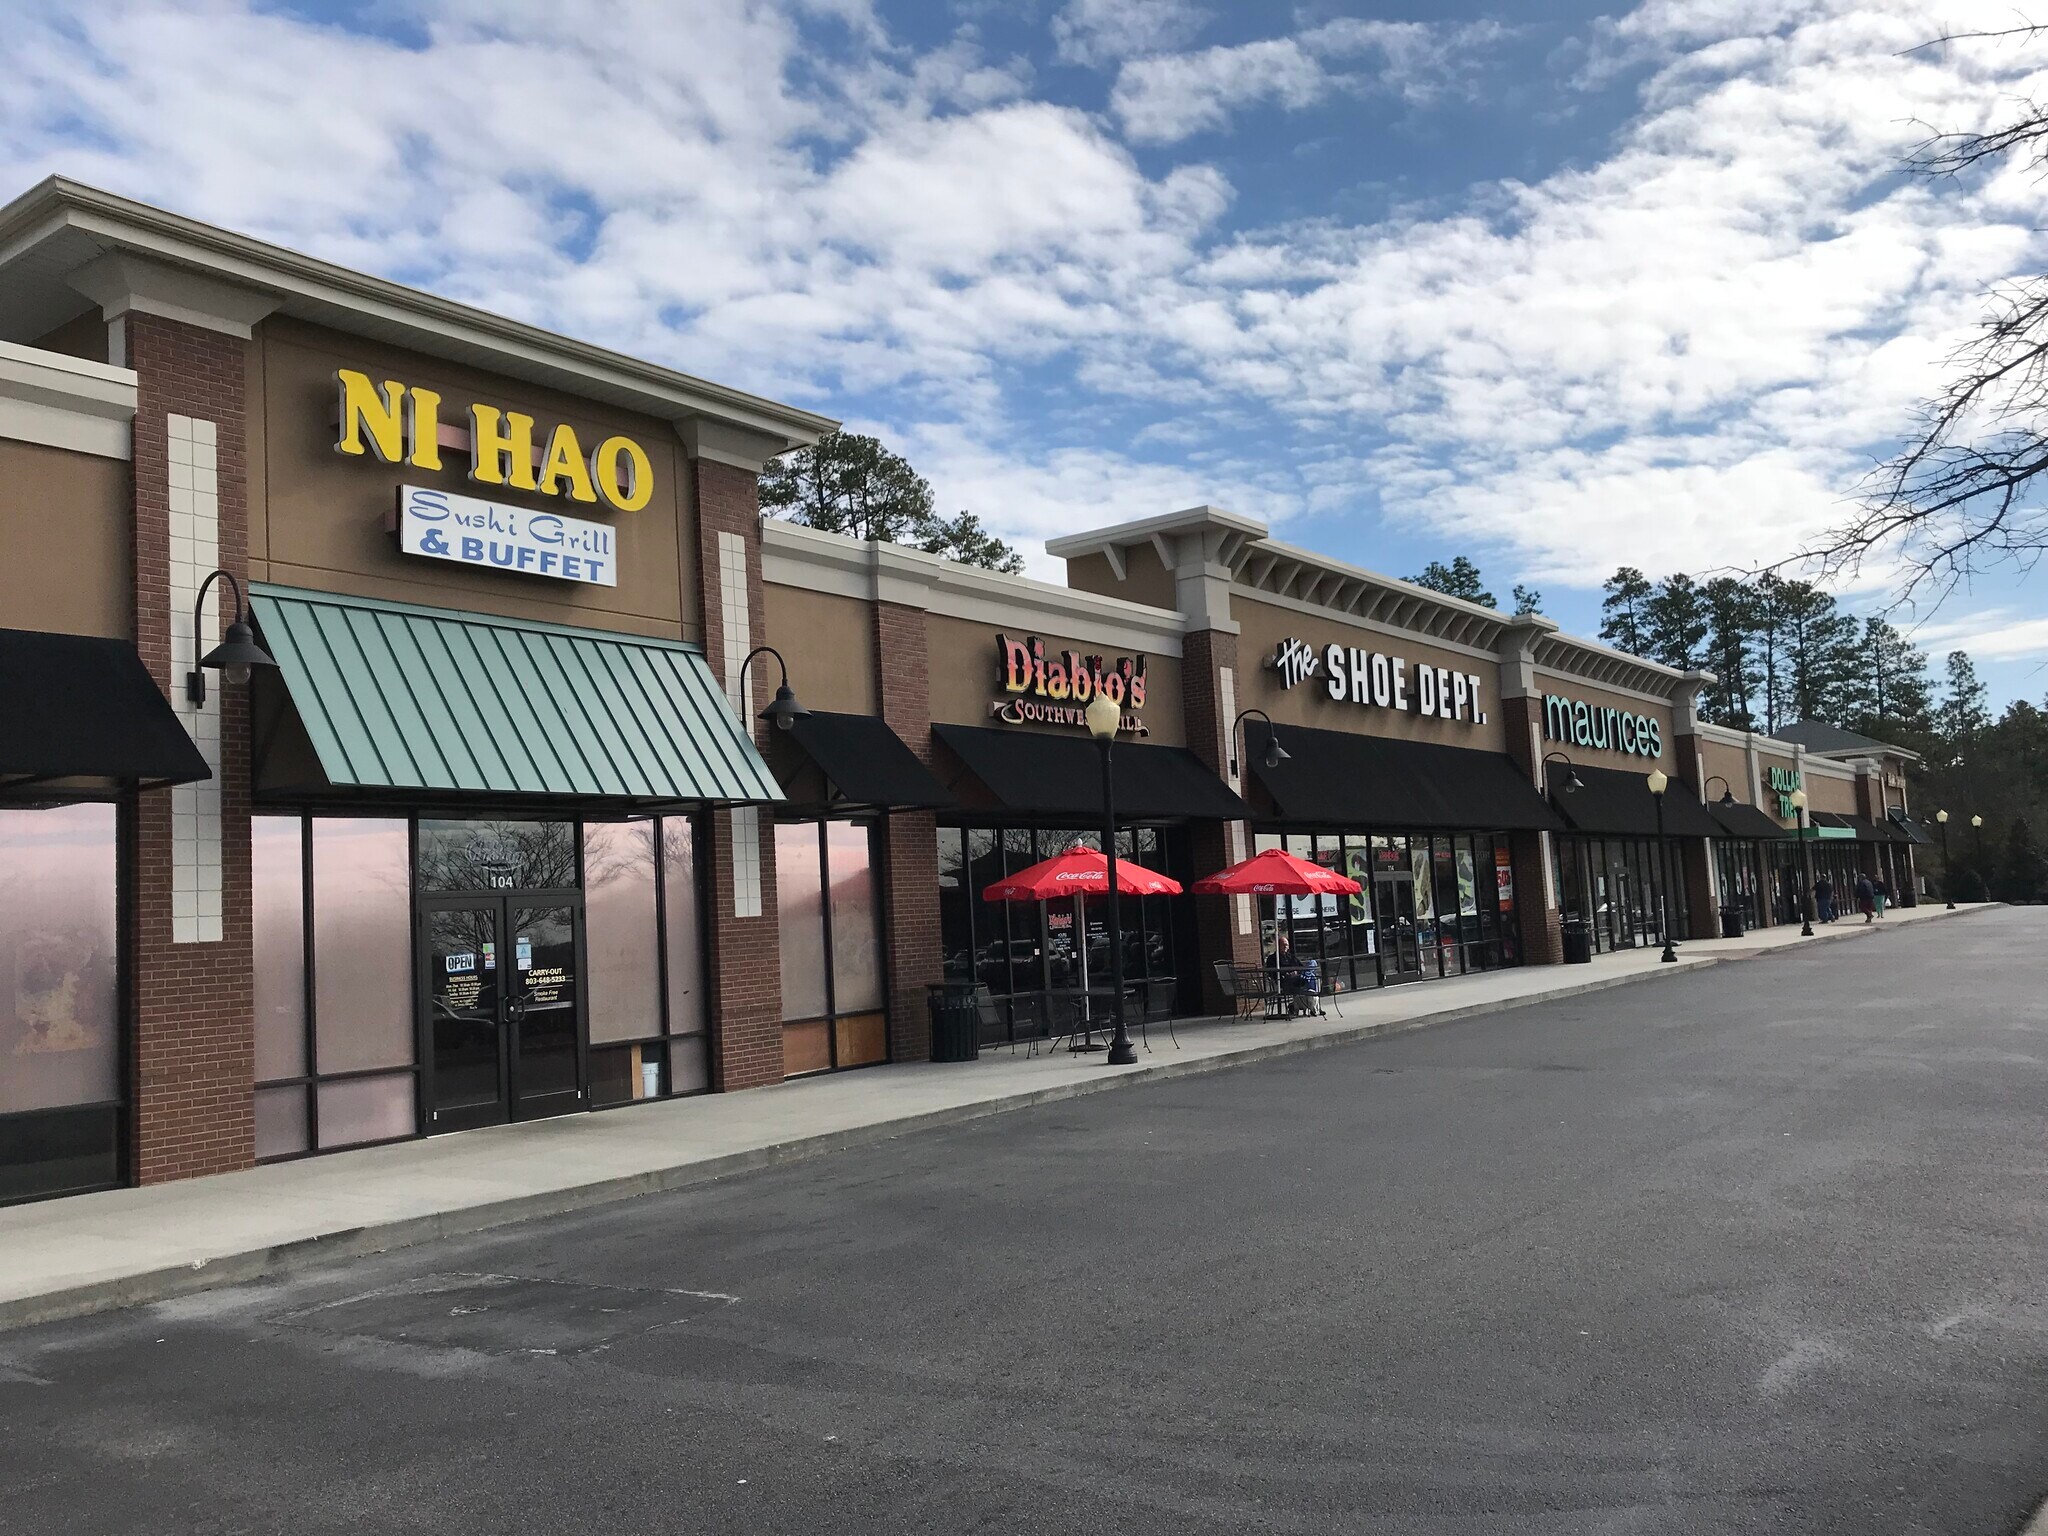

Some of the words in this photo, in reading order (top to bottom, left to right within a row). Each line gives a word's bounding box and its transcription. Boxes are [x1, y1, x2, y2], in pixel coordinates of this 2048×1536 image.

[336, 368, 443, 471] NI
[469, 402, 654, 512] HAO
[408, 490, 518, 537] Sushi
[527, 514, 610, 556] Grill
[419, 528, 451, 556] &
[461, 536, 605, 582] BUFFET
[999, 633, 1148, 710] Diablo's
[1275, 636, 1320, 691] the
[1326, 643, 1409, 712] SHOE
[1417, 663, 1488, 726] DEPT.
[1000, 698, 1090, 727] SOUTHWE
[1544, 693, 1663, 759] maurices
[1770, 766, 1801, 793] DOLLAR
[490, 876, 514, 888] 104
[1055, 870, 1105, 881] Coca-Cola
[447, 955, 473, 970] OPEN
[528, 967, 563, 977] CARRY-OUT
